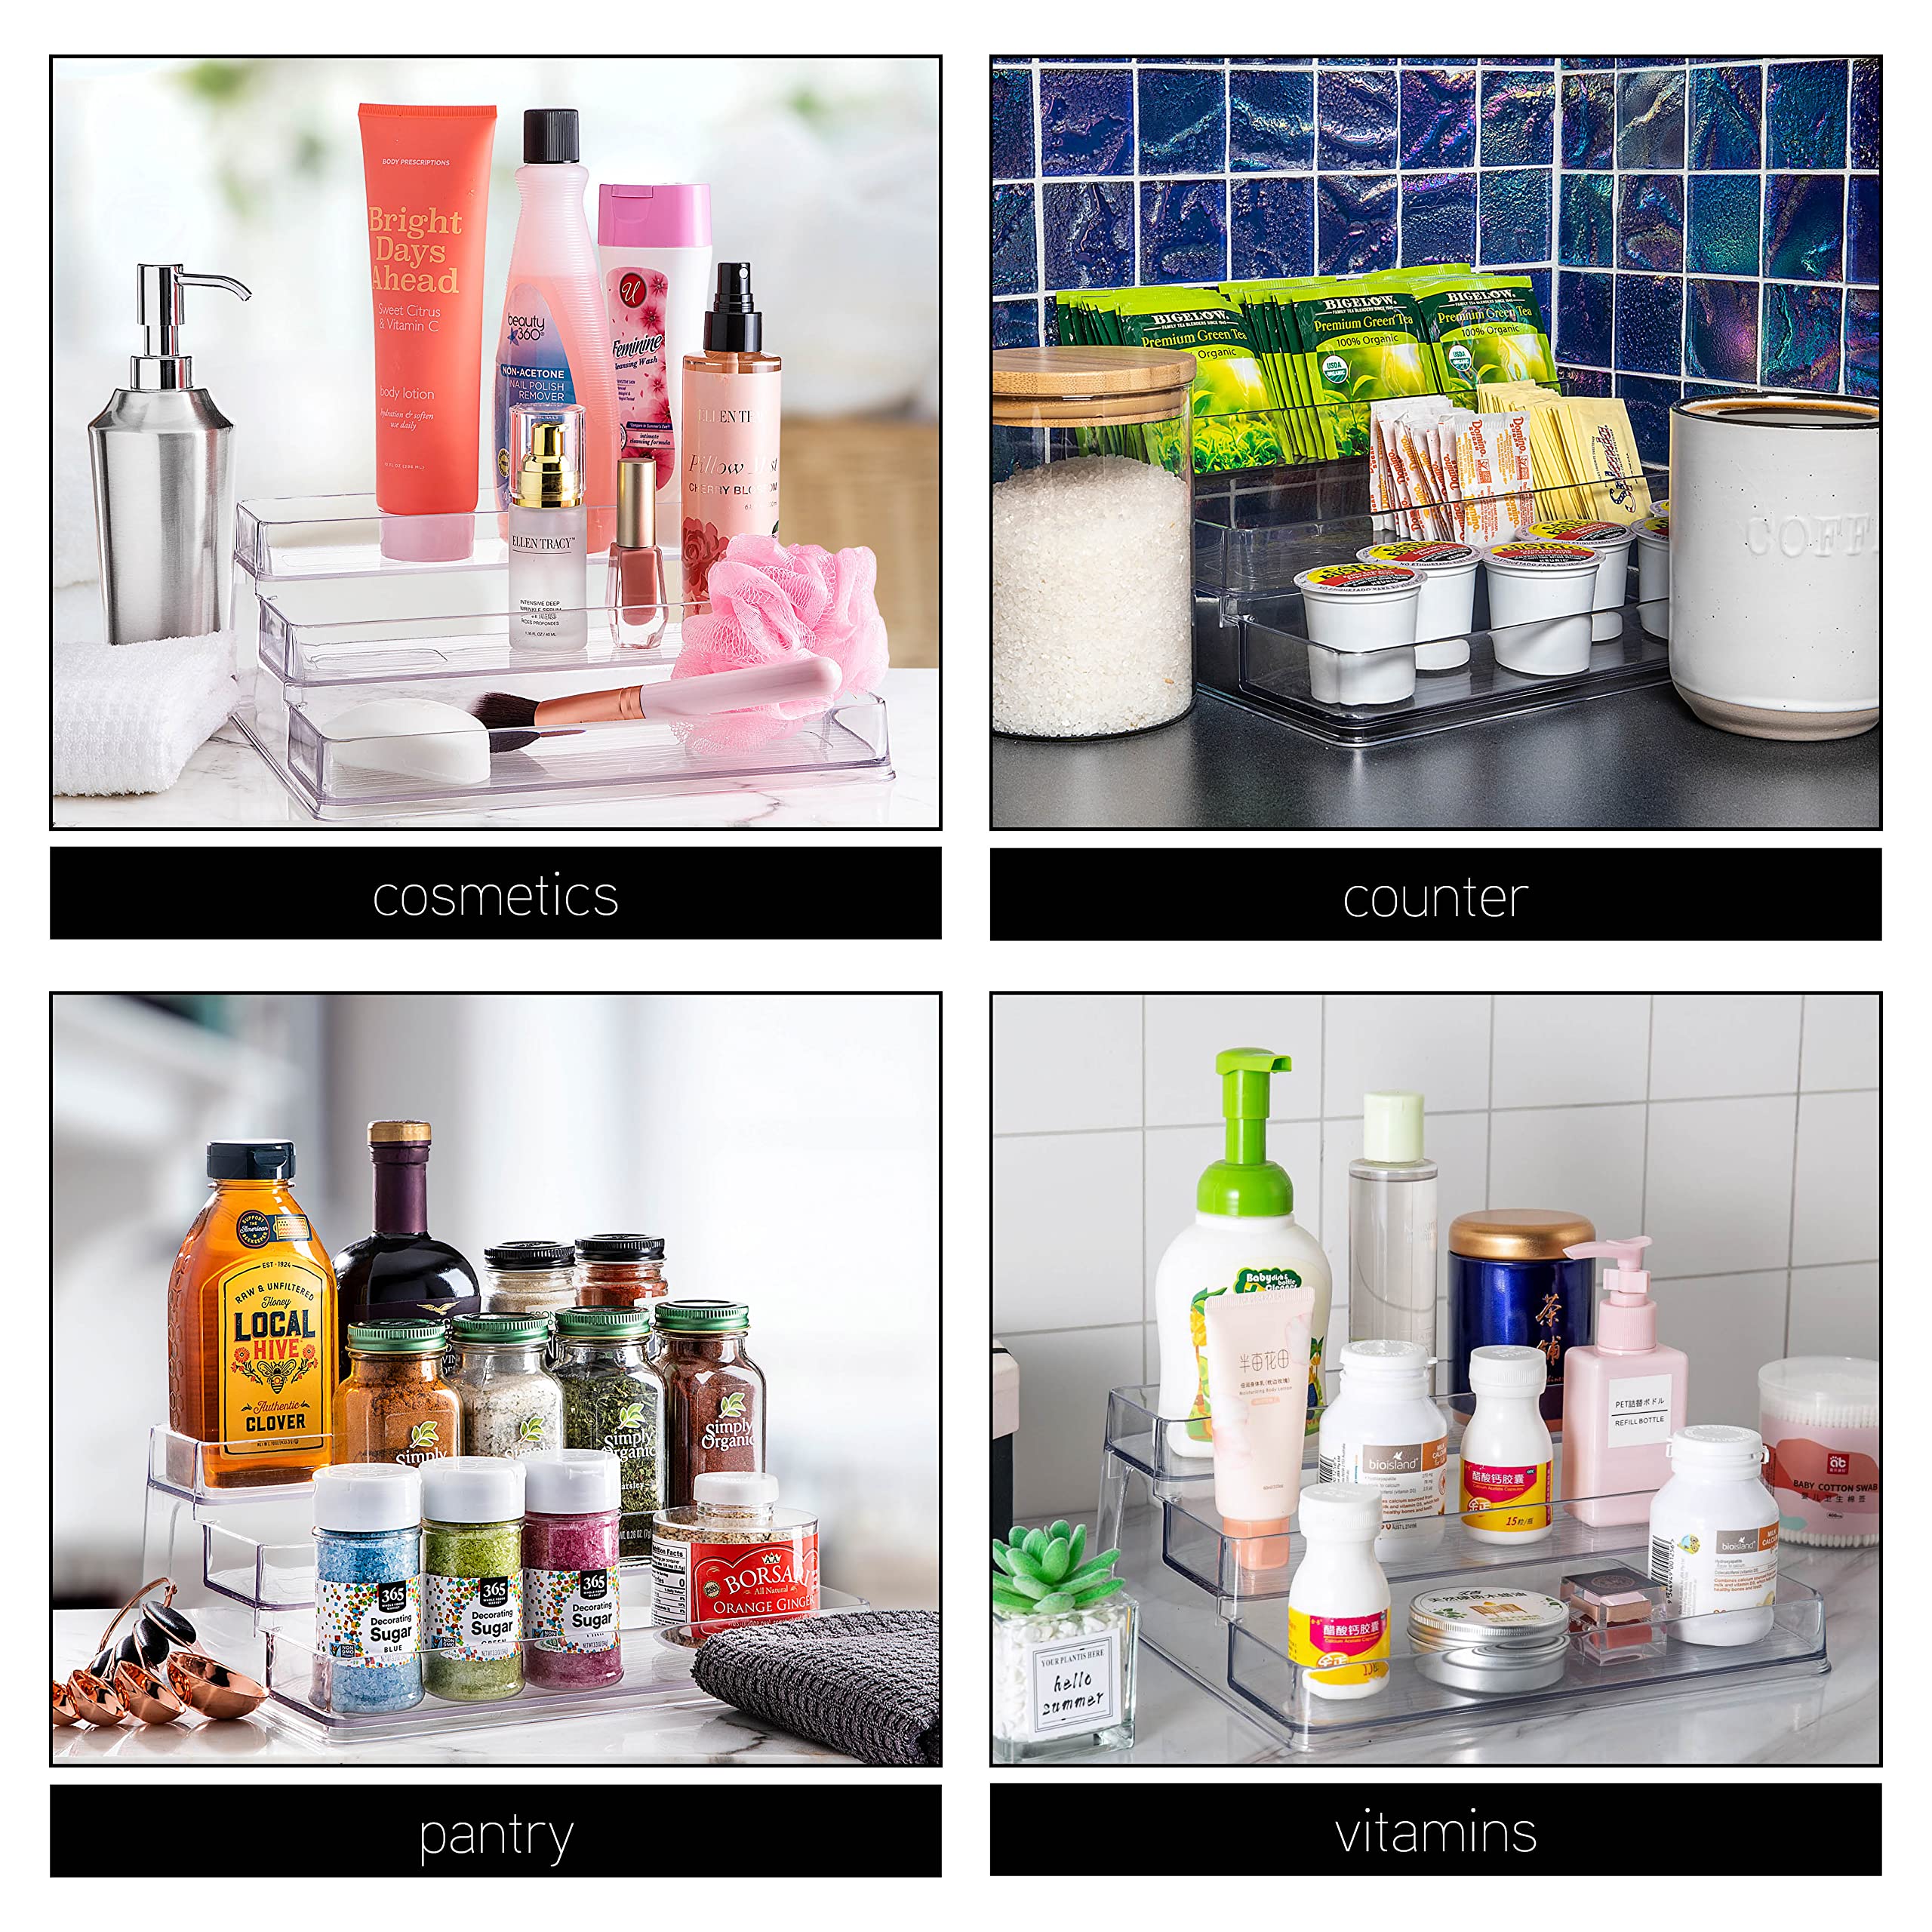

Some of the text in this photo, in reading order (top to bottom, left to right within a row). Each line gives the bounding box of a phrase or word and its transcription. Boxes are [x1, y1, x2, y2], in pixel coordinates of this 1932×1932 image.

[369, 206, 462, 239] Bright
[376, 236, 445, 269] Days
[372, 266, 459, 294] Ahead
[378, 303, 441, 318] Sweet Citrus
[1438, 306, 1533, 324] Premium Green Tea
[379, 318, 438, 332] & Vitamin C
[508, 312, 544, 336] beauty
[1313, 313, 1414, 334] Premium Green Tea
[1461, 325, 1521, 337] 100% Organic
[612, 334, 663, 358] Feminine
[1141, 329, 1247, 349] Premium Green Tea
[1336, 334, 1399, 347] 100% Organic
[1198, 348, 1237, 360] Organic
[615, 356, 658, 371] leansing Wash
[503, 367, 565, 379] NON-ACETONE
[510, 380, 565, 391] NAIL POLISH
[380, 386, 435, 401] body lotion
[519, 390, 565, 401] REMOVER
[380, 408, 434, 422] hydration soften
[390, 420, 417, 431] use daily
[1469, 427, 1478, 451] SUGAR
[1510, 423, 1518, 447] SUGAR
[689, 454, 744, 475] Pillow
[689, 483, 730, 495] CHERRY
[512, 535, 538, 549] ELLEN
[1746, 513, 1879, 558] COFF
[242, 1215, 265, 1224] SUPPORT
[240, 1222, 269, 1234] American
[242, 1232, 268, 1244] BEEKEEPER
[1247, 1273, 1284, 1285] Baby dish
[1278, 1278, 1297, 1287] bottle
[235, 1282, 314, 1304] RAW & UNFILTERED
[261, 1297, 291, 1309] Honey
[234, 1309, 315, 1343] LOCAL
[254, 1400, 300, 1414] Authentic
[246, 1414, 306, 1432] CLOVER
[705, 1419, 754, 1438] Simply
[1615, 1416, 1665, 1426] REFILL BOTTLE
[604, 1429, 653, 1448] Simply
[701, 1432, 755, 1452] Organic
[1472, 1471, 1524, 1484] 醋酸钙胶囊
[621, 1481, 645, 1490] arsley
[1793, 1480, 1878, 1492] BABY COTTON SWAB
[667, 1549, 683, 1558] Facts
[483, 1582, 506, 1598] 365
[583, 1575, 605, 1590] 365
[382, 1587, 405, 1603] 365
[754, 1586, 789, 1595] All Natural
[572, 1601, 612, 1612] Decorating
[371, 1614, 412, 1626] Decorating
[472, 1608, 513, 1621] Decorating
[572, 1613, 613, 1629] Sugar
[370, 1625, 412, 1642] Sugar
[471, 1620, 513, 1638] Sugar
[1323, 1621, 1380, 1636] 醋酸钙胶囊
[384, 1644, 402, 1653] BLUE
[1041, 1648, 1105, 1667] YOUR PLANTIS HERE
[1054, 1671, 1092, 1693] hello
[1042, 1691, 1104, 1715] summer
